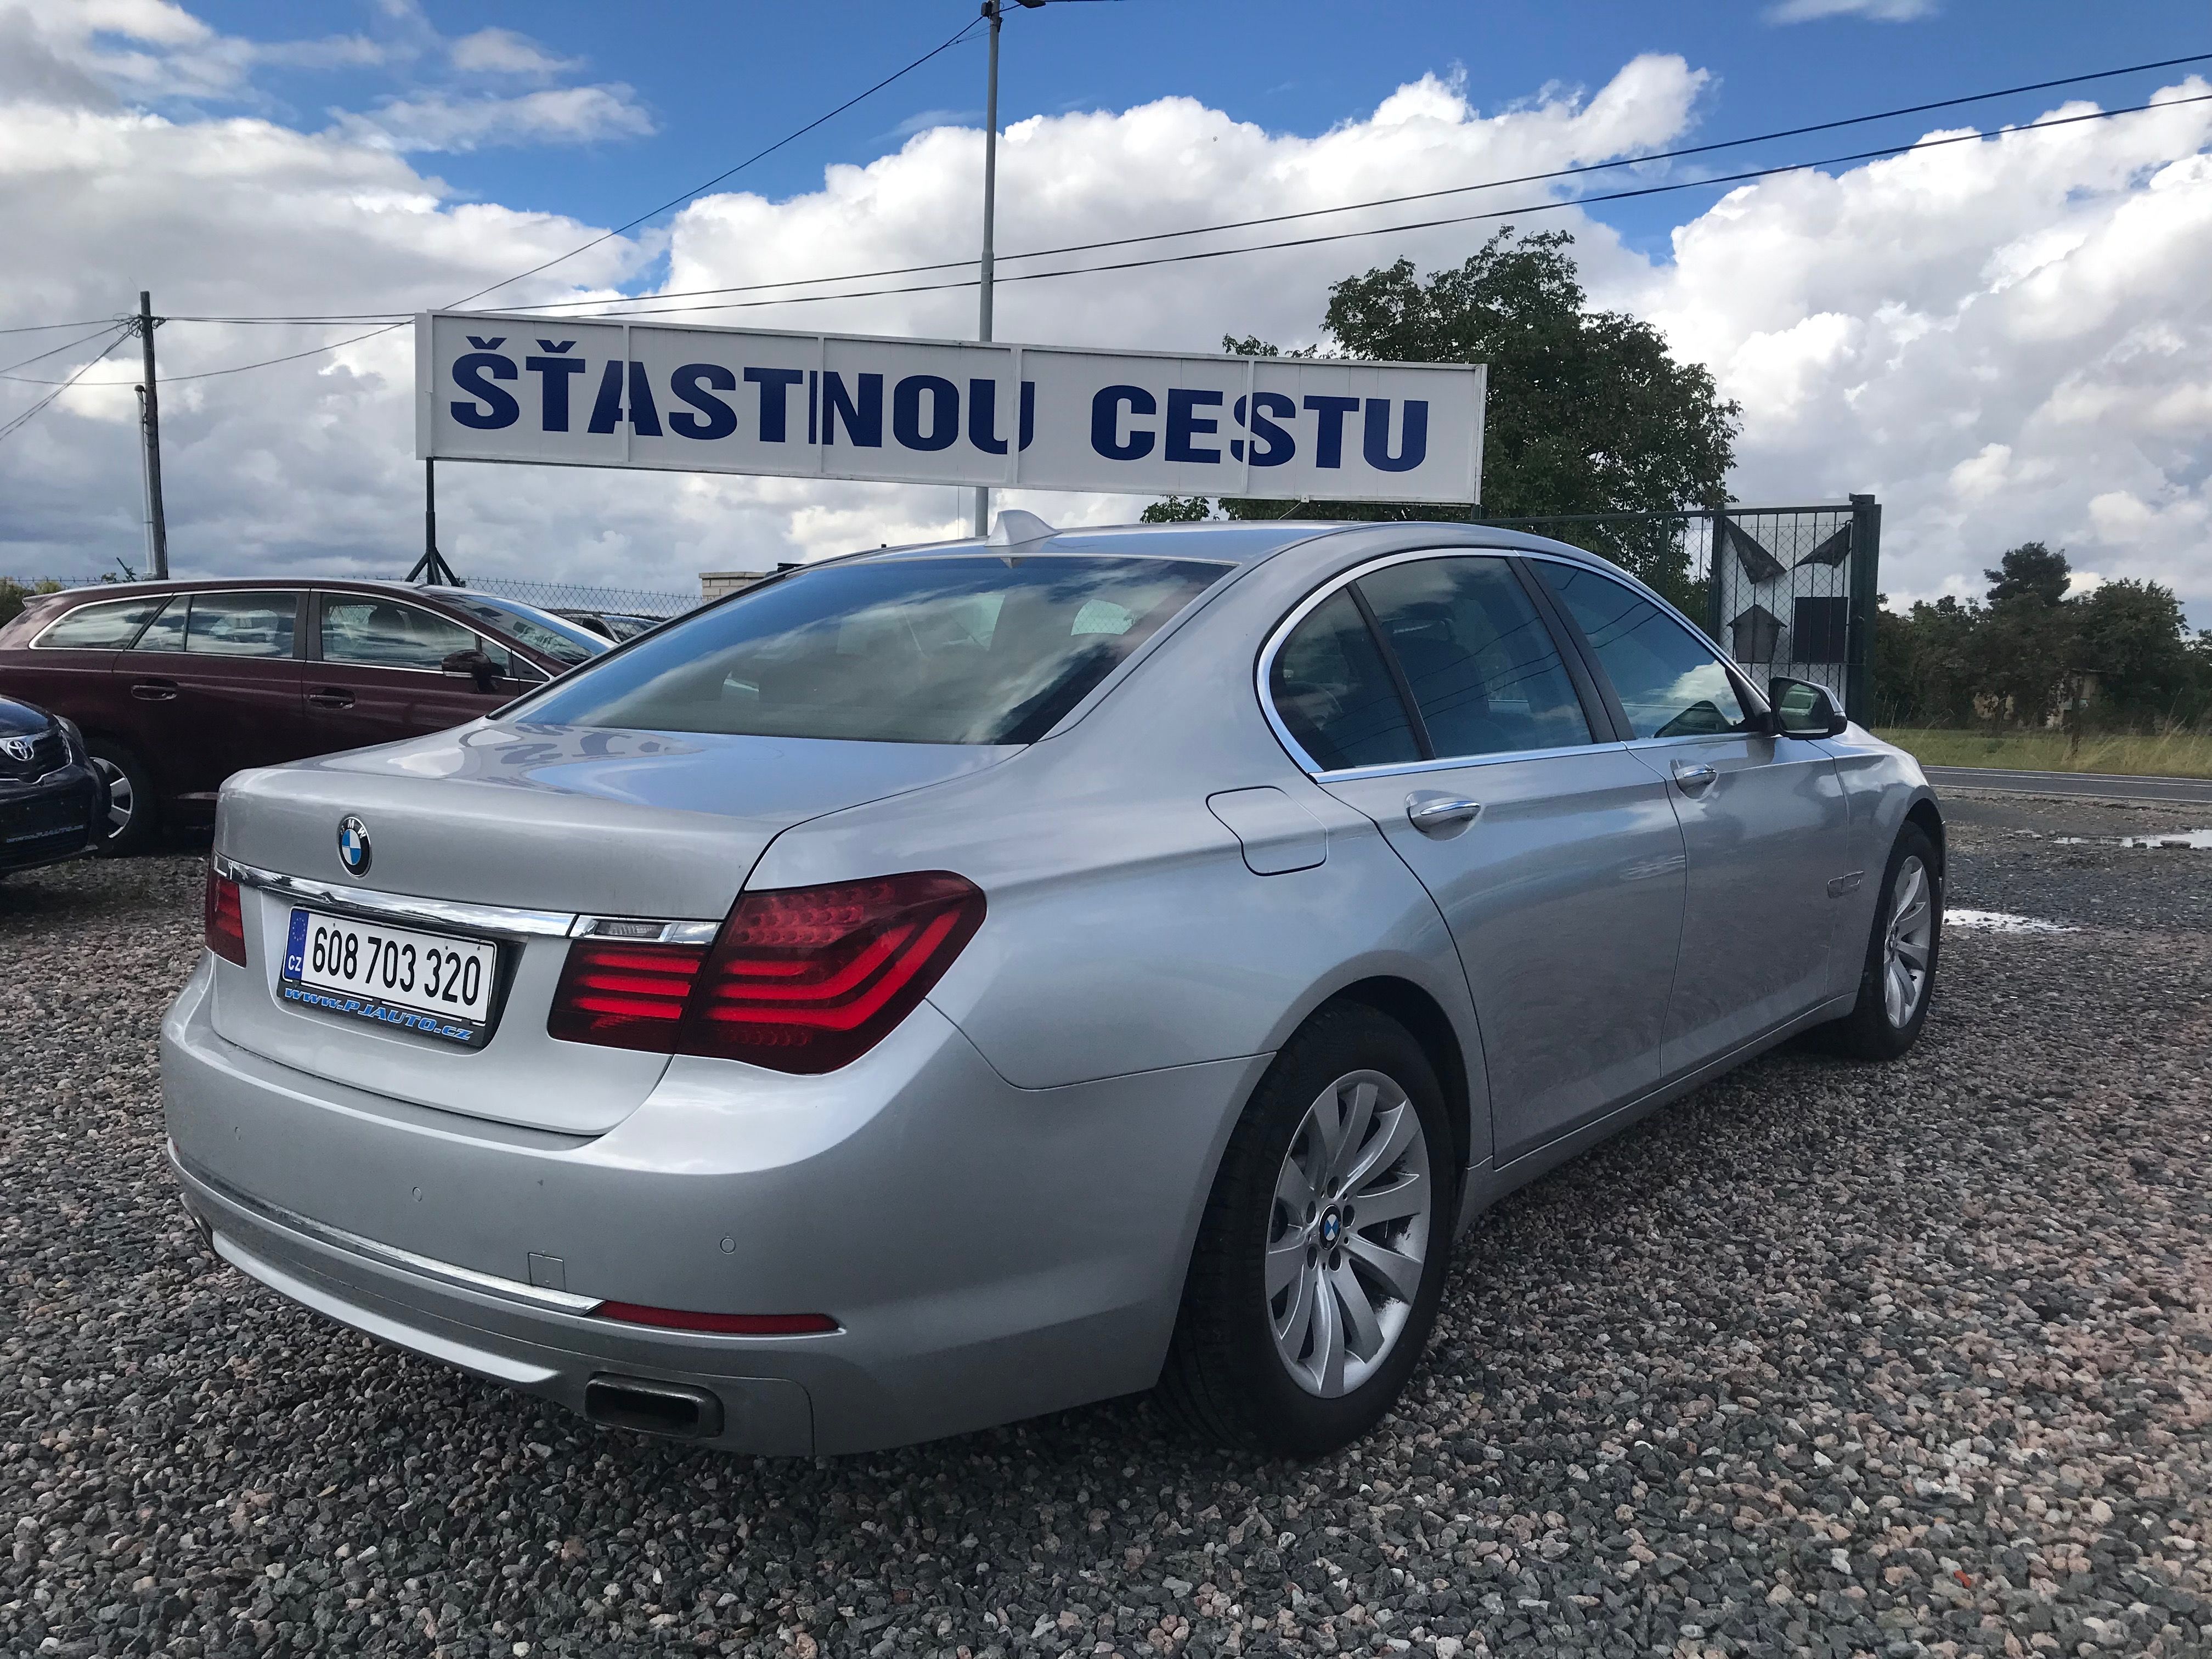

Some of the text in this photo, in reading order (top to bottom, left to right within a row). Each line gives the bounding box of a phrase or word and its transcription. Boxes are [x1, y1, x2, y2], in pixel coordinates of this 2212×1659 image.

[450, 335, 1428, 472] ŠŤASTNOU CESTU
[288, 955, 301, 972] CZ
[312, 927, 481, 1006] 608 703 320
